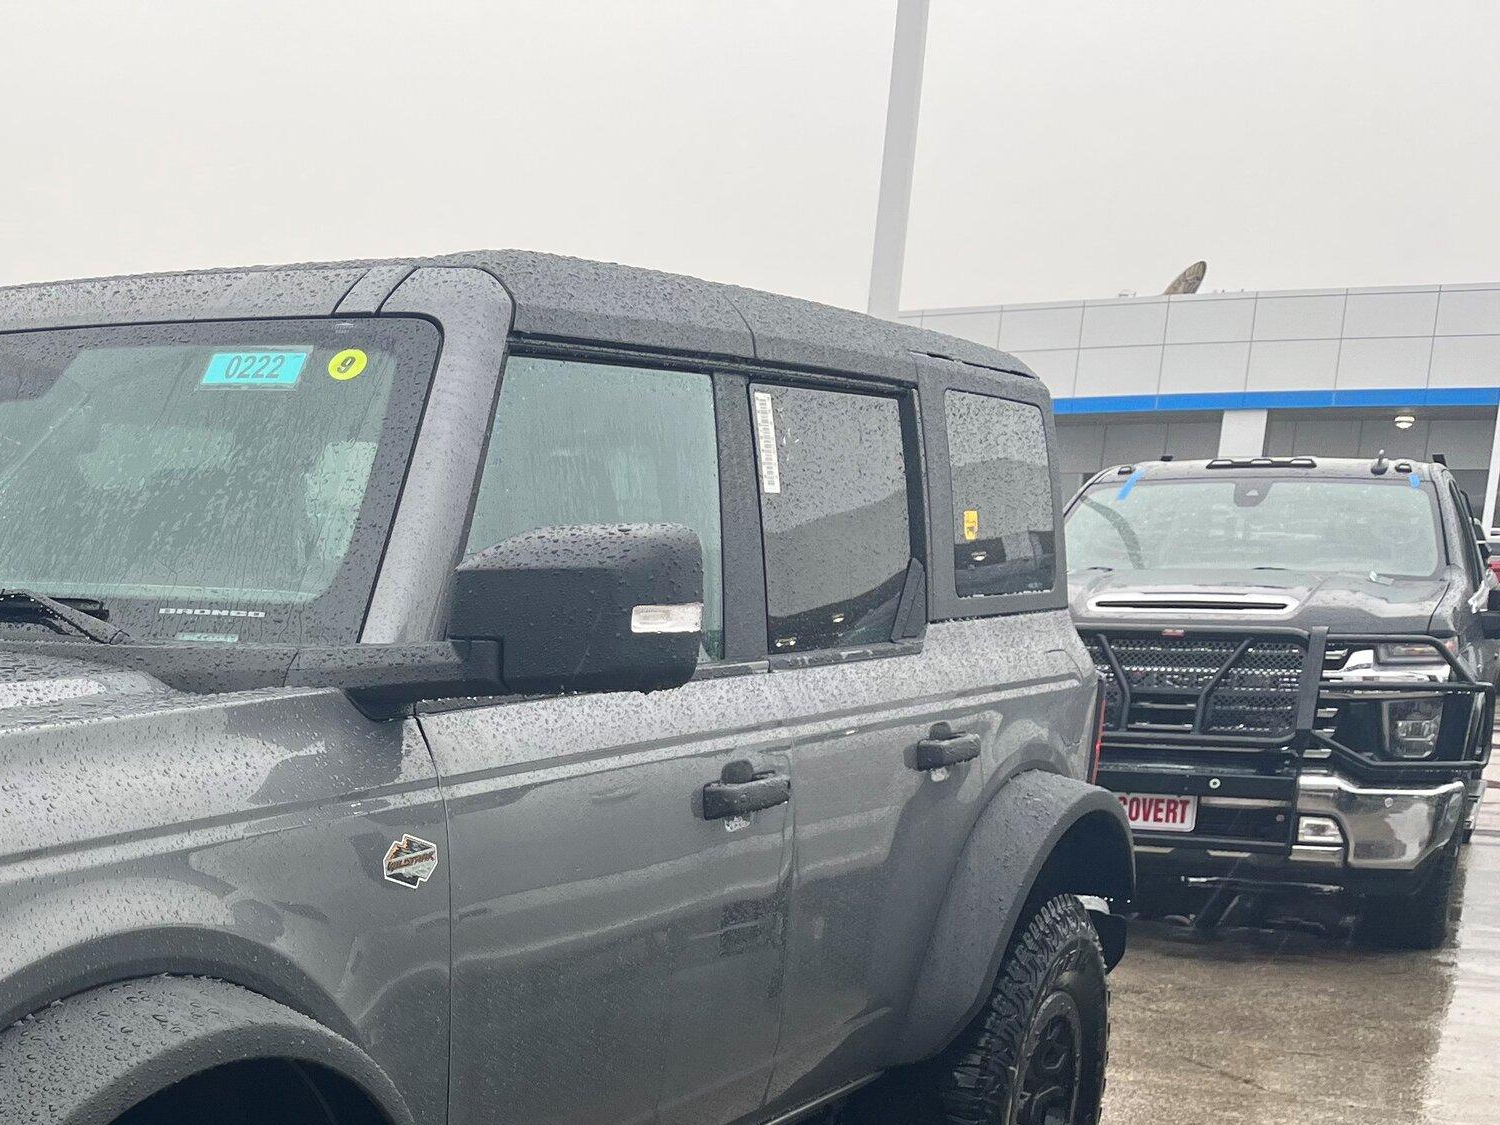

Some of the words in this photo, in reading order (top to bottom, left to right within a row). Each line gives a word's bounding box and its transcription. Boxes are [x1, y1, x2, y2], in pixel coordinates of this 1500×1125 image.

[225, 355, 286, 379] 0222
[336, 356, 356, 374] 9
[159, 607, 266, 618] BRONCO
